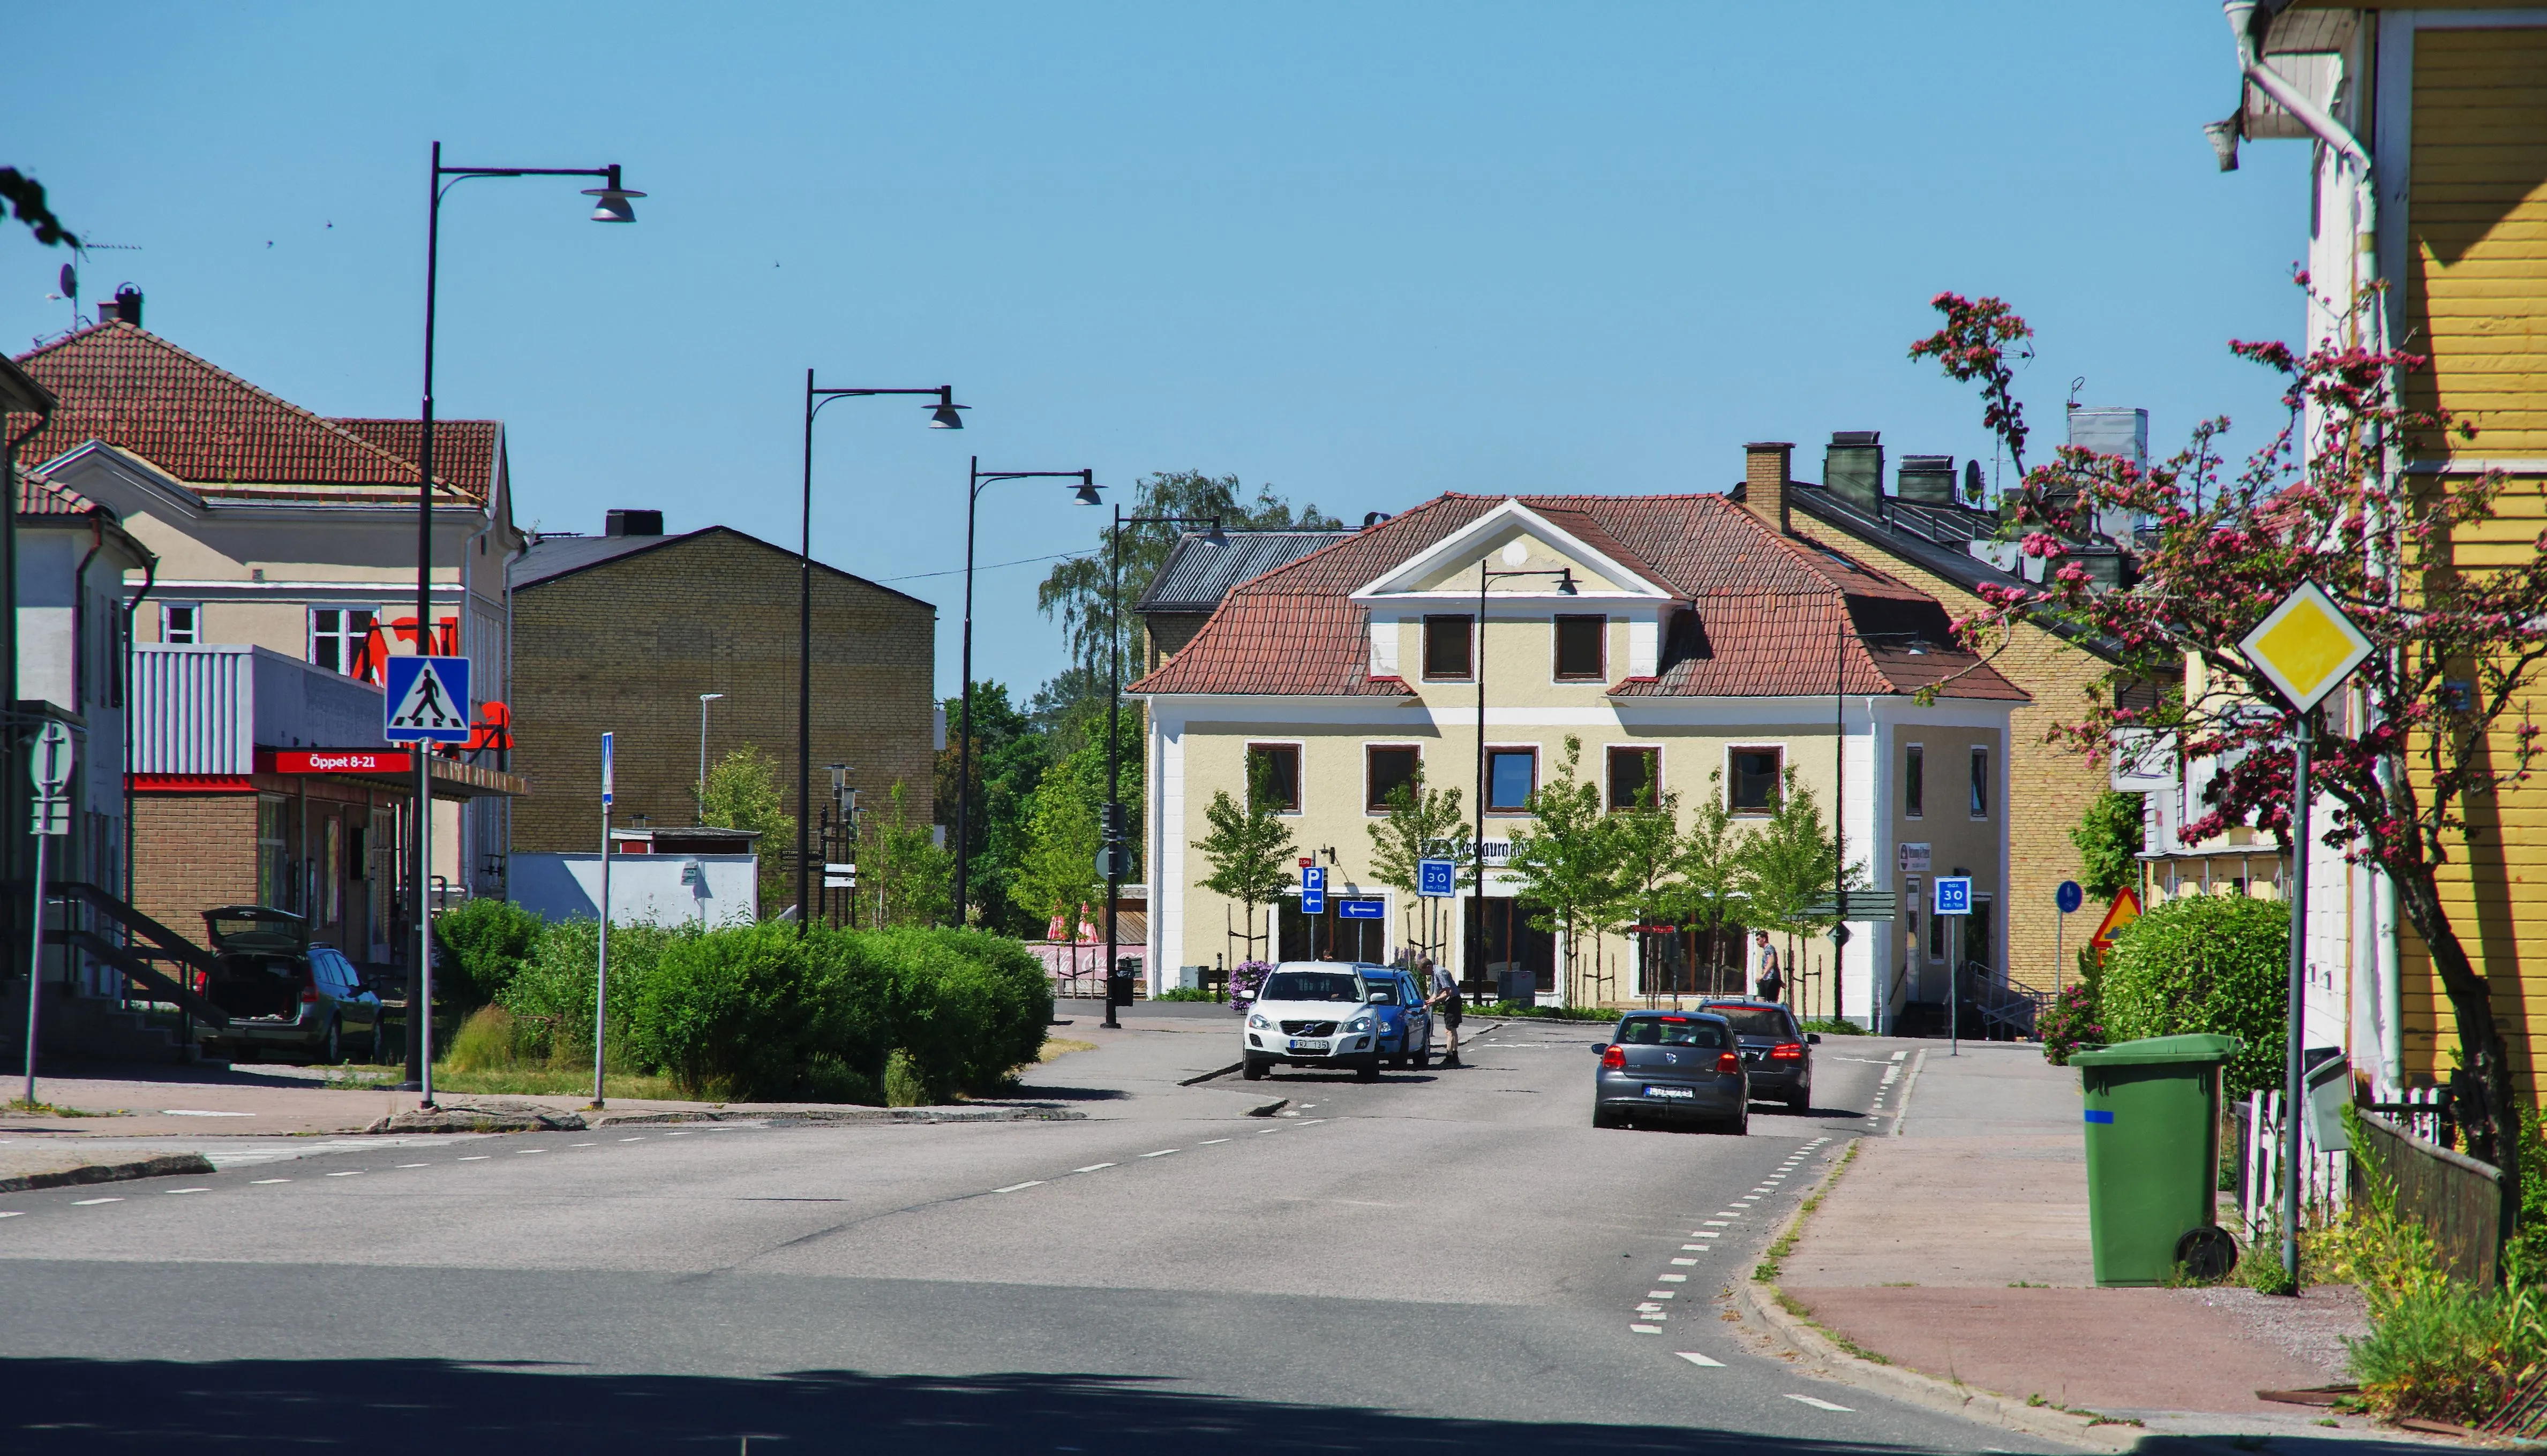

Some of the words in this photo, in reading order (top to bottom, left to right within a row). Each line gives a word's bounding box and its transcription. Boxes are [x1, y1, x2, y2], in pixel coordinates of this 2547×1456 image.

[310, 753, 348, 770] Öppet
[350, 756, 375, 767] 8-21
[1308, 870, 1320, 887] P
[1427, 873, 1446, 883] 30
[1943, 890, 1963, 900] 30
